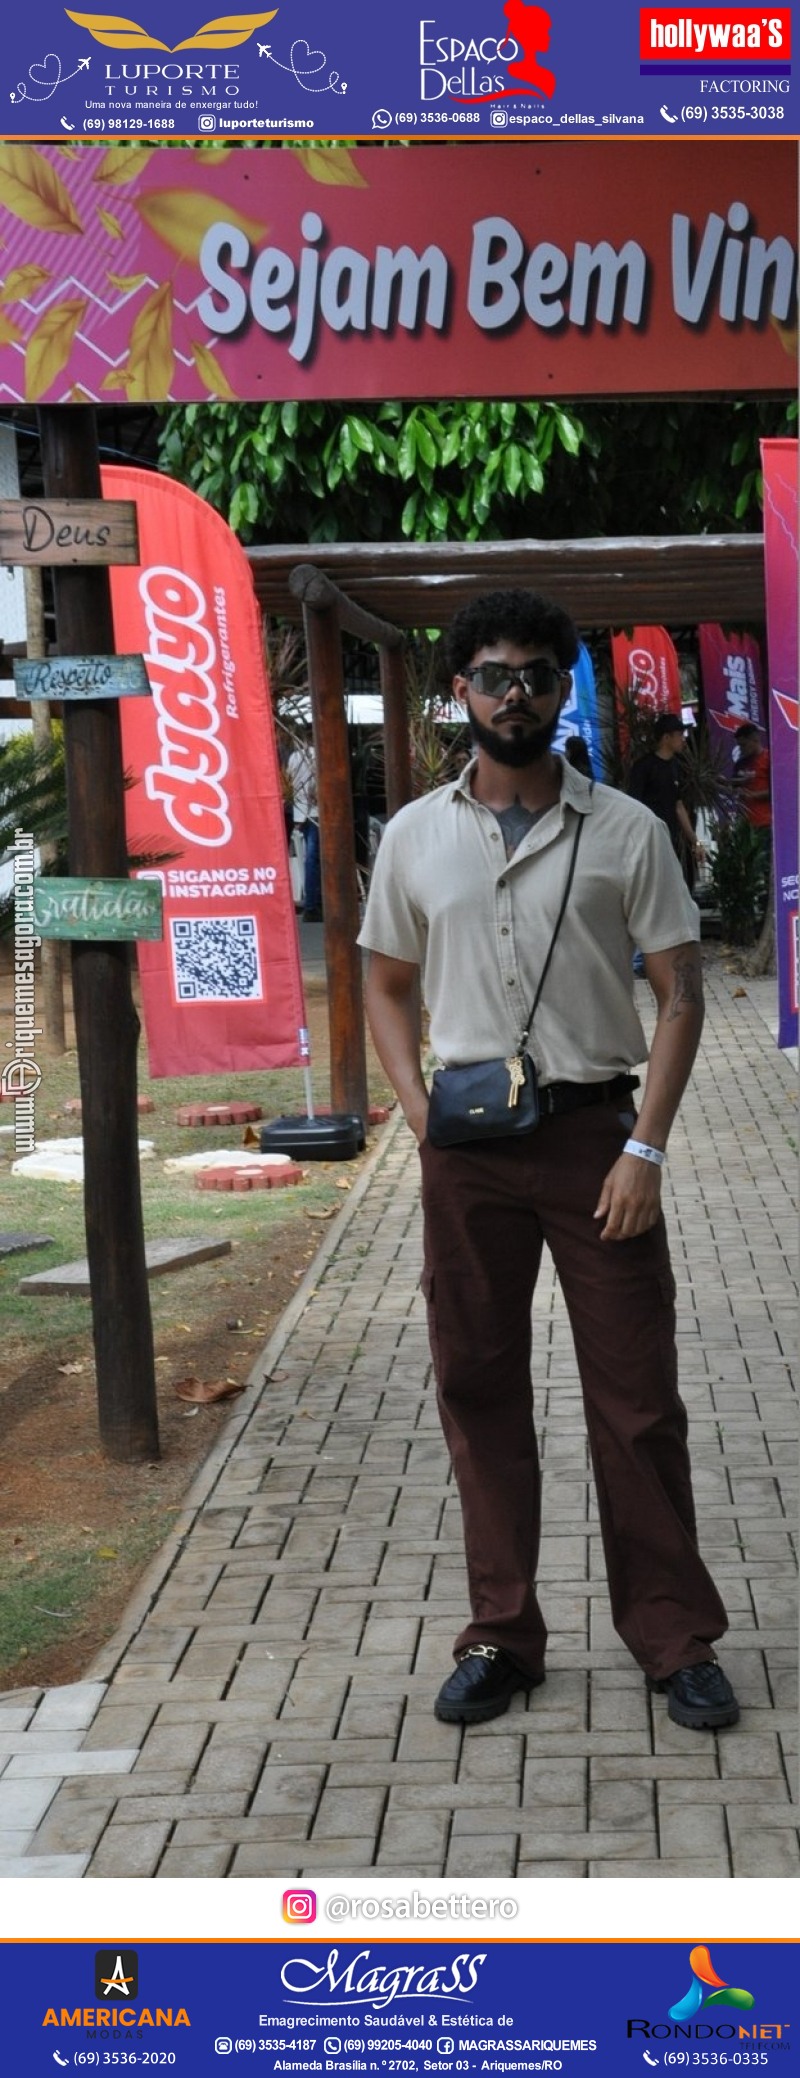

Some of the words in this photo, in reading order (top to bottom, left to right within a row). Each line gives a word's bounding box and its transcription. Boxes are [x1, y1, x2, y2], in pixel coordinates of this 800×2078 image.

[199, 212, 447, 361] Sejam
[467, 216, 646, 329] Bem
[22, 507, 110, 552] Deus
[214, 585, 238, 719] Refrigerantes
[25, 660, 112, 694] Respeito
[723, 655, 749, 720] Mais
[139, 565, 232, 847] dydyo
[168, 868, 249, 883] SIGANOS
[254, 867, 276, 880] NO
[169, 882, 274, 897] INSTAGRAM
[33, 887, 157, 927] Gratidão
